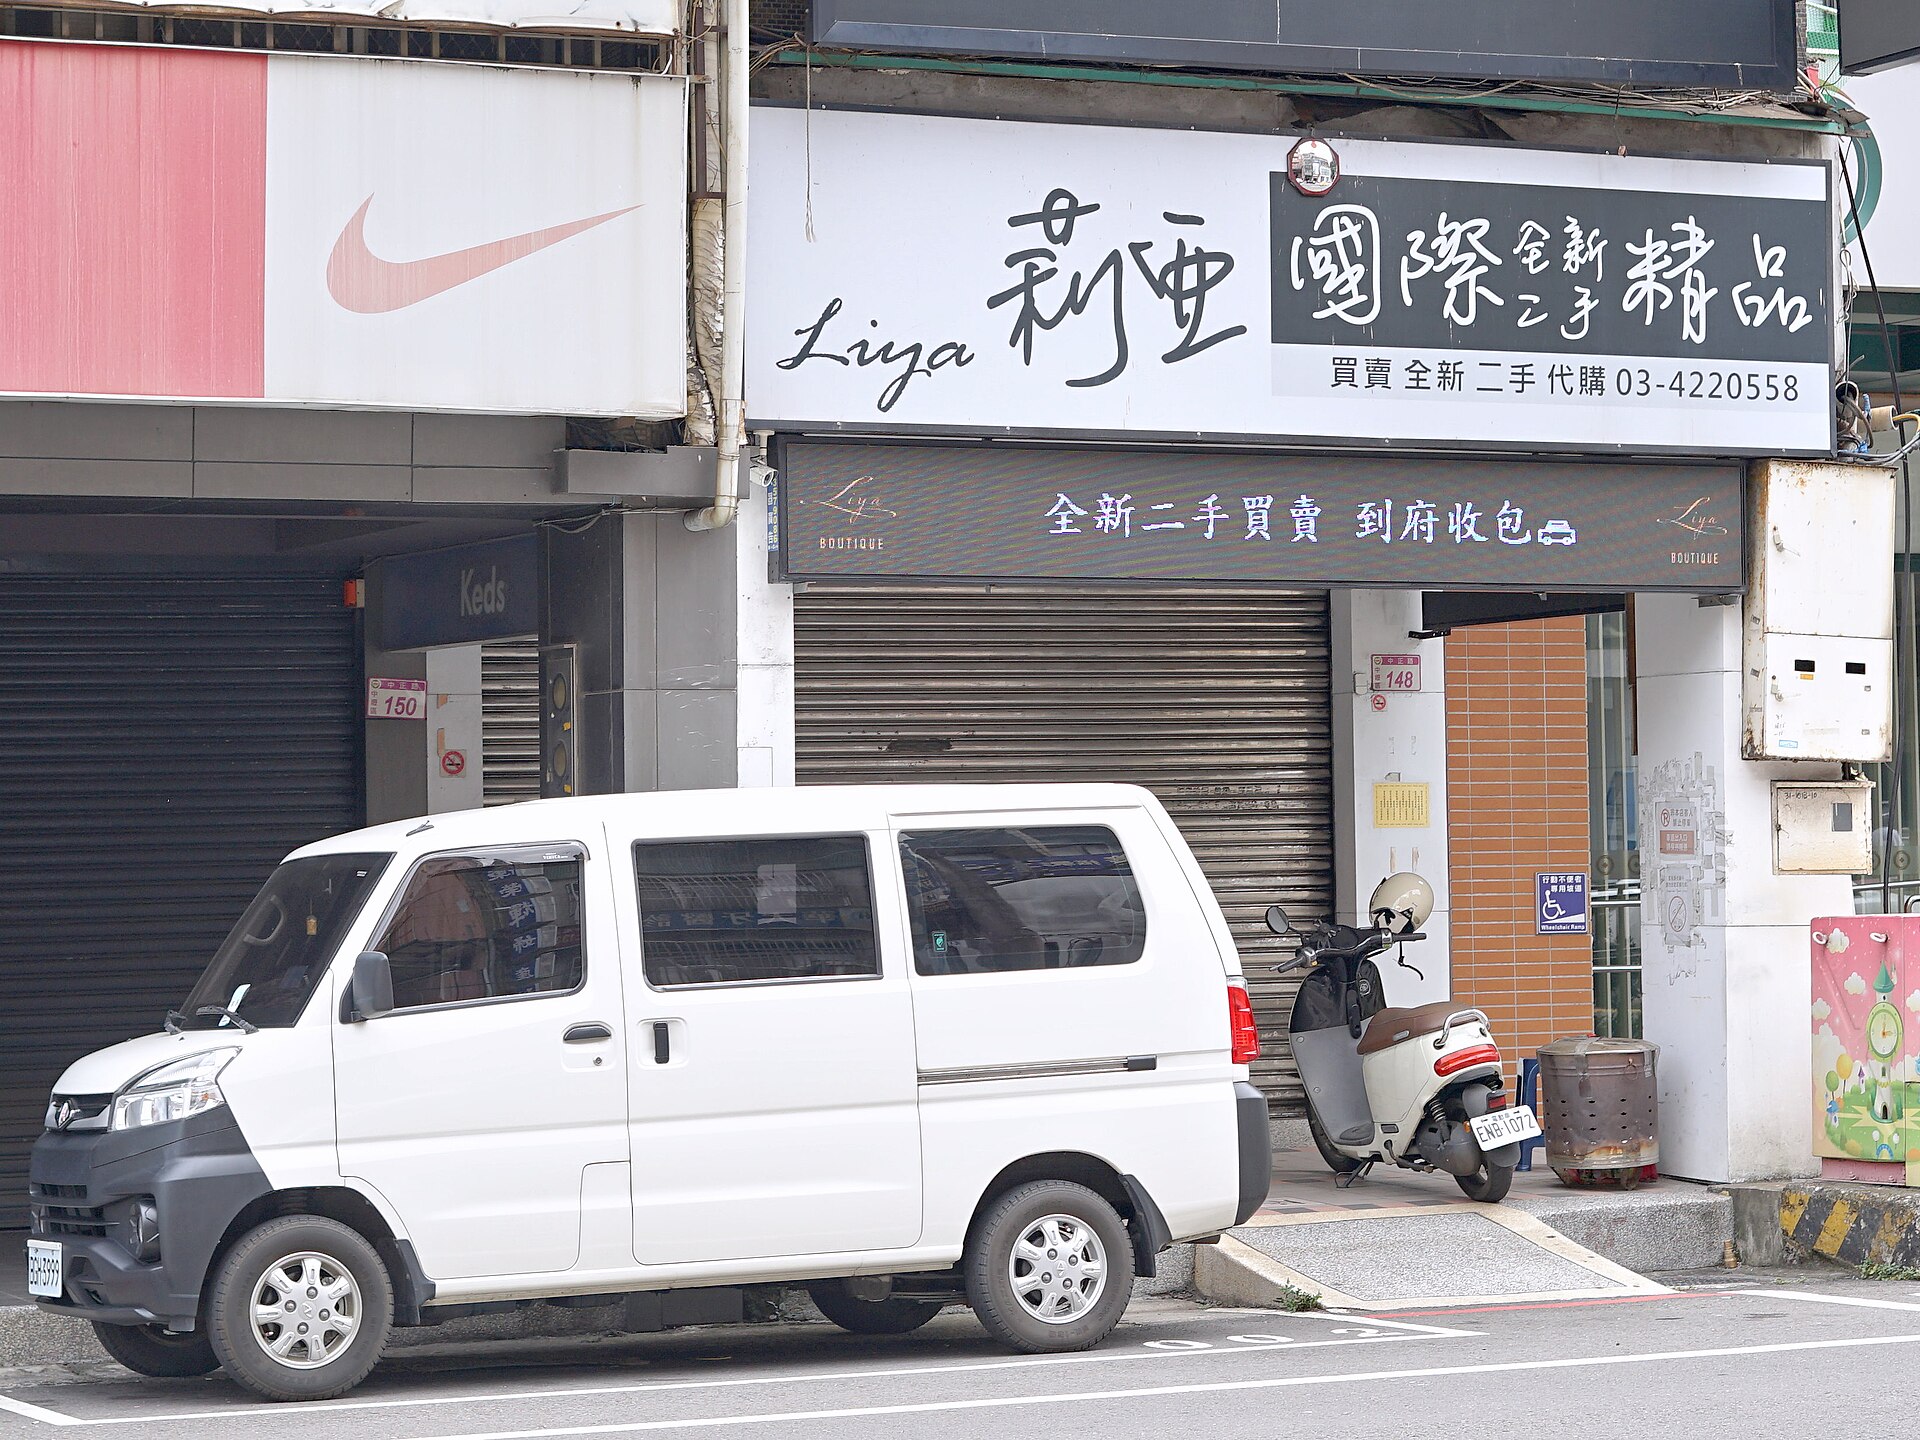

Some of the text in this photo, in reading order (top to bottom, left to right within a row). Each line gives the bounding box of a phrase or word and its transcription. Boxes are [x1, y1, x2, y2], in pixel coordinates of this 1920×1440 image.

[1291, 204, 1505, 327] 國際
[1513, 216, 1608, 282] 全新
[1623, 216, 1813, 345] 精品
[1517, 286, 1600, 340] 二手
[776, 298, 974, 413] Liya
[1331, 357, 1799, 401] 買賣 全新 二手 代購 03-4220558
[1044, 492, 1532, 545] 全新二手買賣 到府收包
[820, 537, 884, 550] BOUTIQUE
[1671, 552, 1719, 564] BOUTIQUE
[460, 565, 506, 617] Keds
[1386, 670, 1413, 689] 148
[384, 695, 417, 716] 150
[1542, 875, 1582, 884] 行動不便者
[1550, 884, 1582, 893] 專用坡道
[1476, 1114, 1536, 1143] ENB-1072
